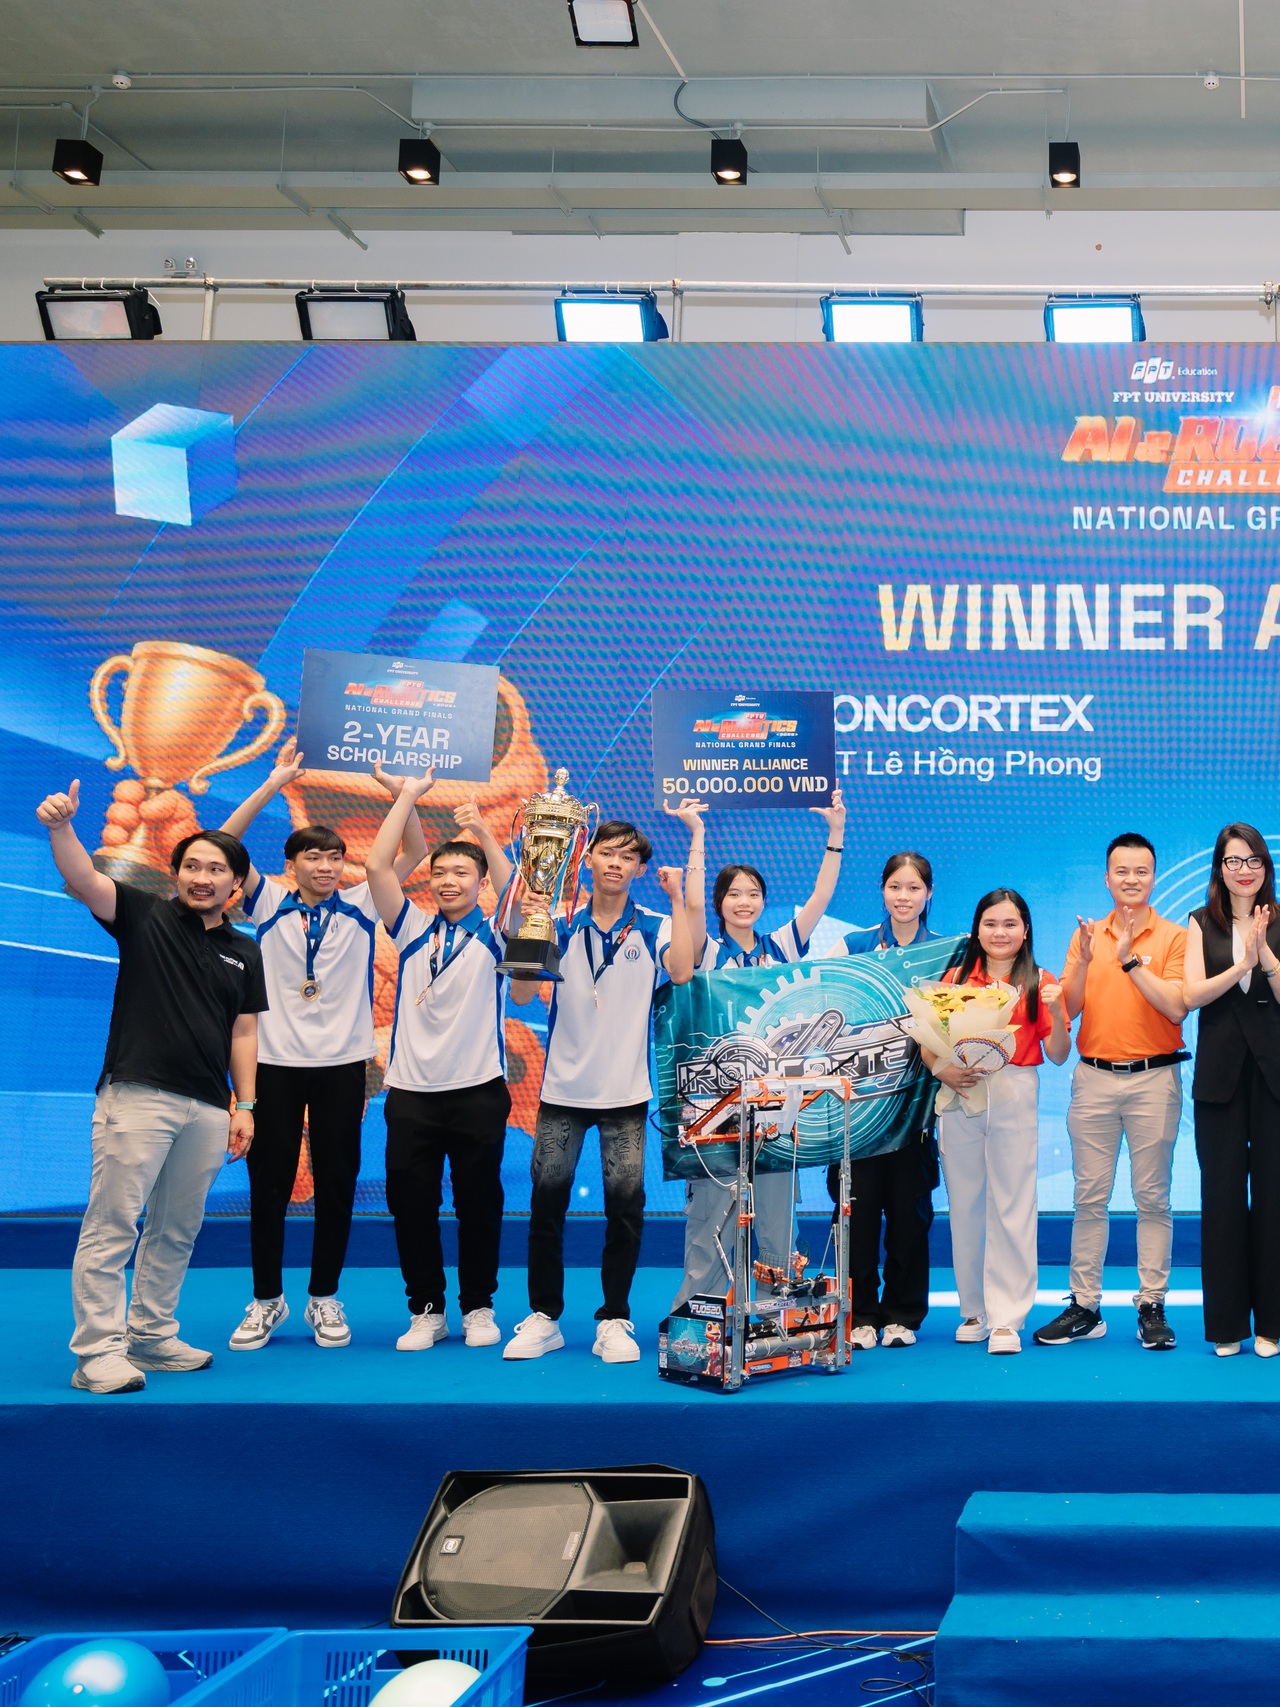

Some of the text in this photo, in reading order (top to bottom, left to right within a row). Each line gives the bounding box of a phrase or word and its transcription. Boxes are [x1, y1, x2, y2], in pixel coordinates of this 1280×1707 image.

[1131, 357, 1218, 384] FPT Education
[1113, 391, 1235, 402] FPT UNIVERSITY
[1073, 506, 1234, 530] NATIONAL
[878, 583, 1225, 651] WINNER
[345, 704, 453, 719] NATIONAL GRAND FINALS
[343, 721, 450, 750] 2-YEAR
[327, 745, 462, 769] SCHOLARSHIP
[683, 759, 808, 771] WINNER ALLIANCE
[867, 750, 903, 775] Lê
[914, 746, 995, 782] Hồng
[1006, 750, 1102, 782] Phong
[662, 777, 828, 794] 50.000.000 VND
